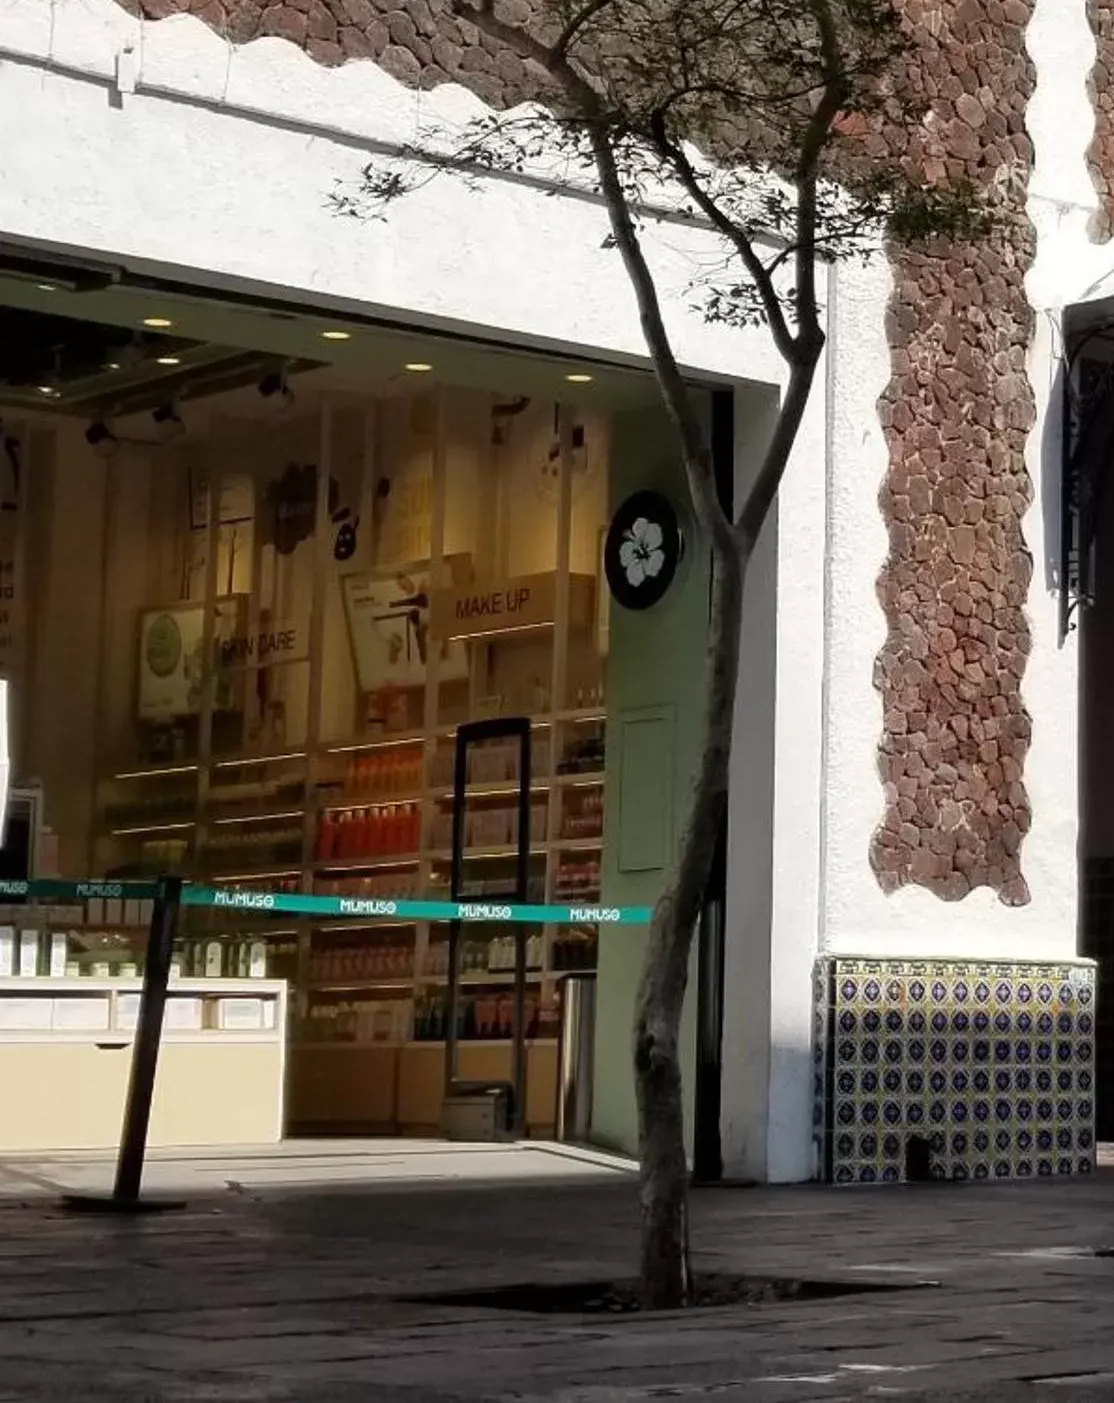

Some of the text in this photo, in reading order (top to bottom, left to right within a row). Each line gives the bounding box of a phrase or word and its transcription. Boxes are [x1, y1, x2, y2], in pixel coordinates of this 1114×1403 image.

[456, 588, 531, 619] MAKE UP
[214, 891, 620, 922] MUMUSO MUMUSO MUMUSO MUMUSO
